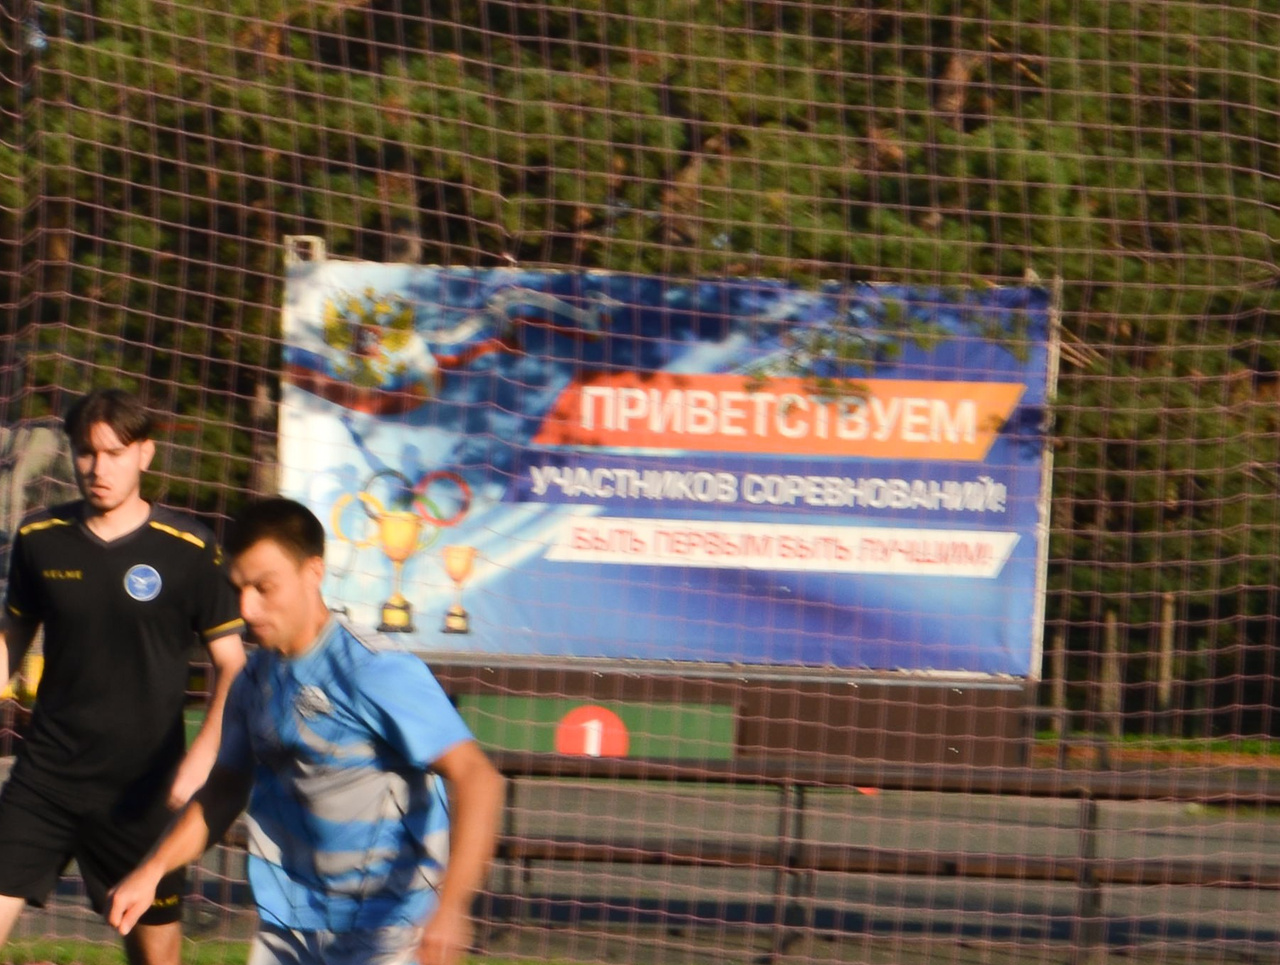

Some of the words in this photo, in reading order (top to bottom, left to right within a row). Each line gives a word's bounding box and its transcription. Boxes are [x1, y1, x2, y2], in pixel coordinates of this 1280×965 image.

[579, 385, 977, 443] ПРИВЕТСТВУЕМ
[530, 465, 738, 502] УЧАСТНИКОВ
[572, 527, 648, 554] БЫТЬ
[777, 534, 851, 561] БЫТЬ
